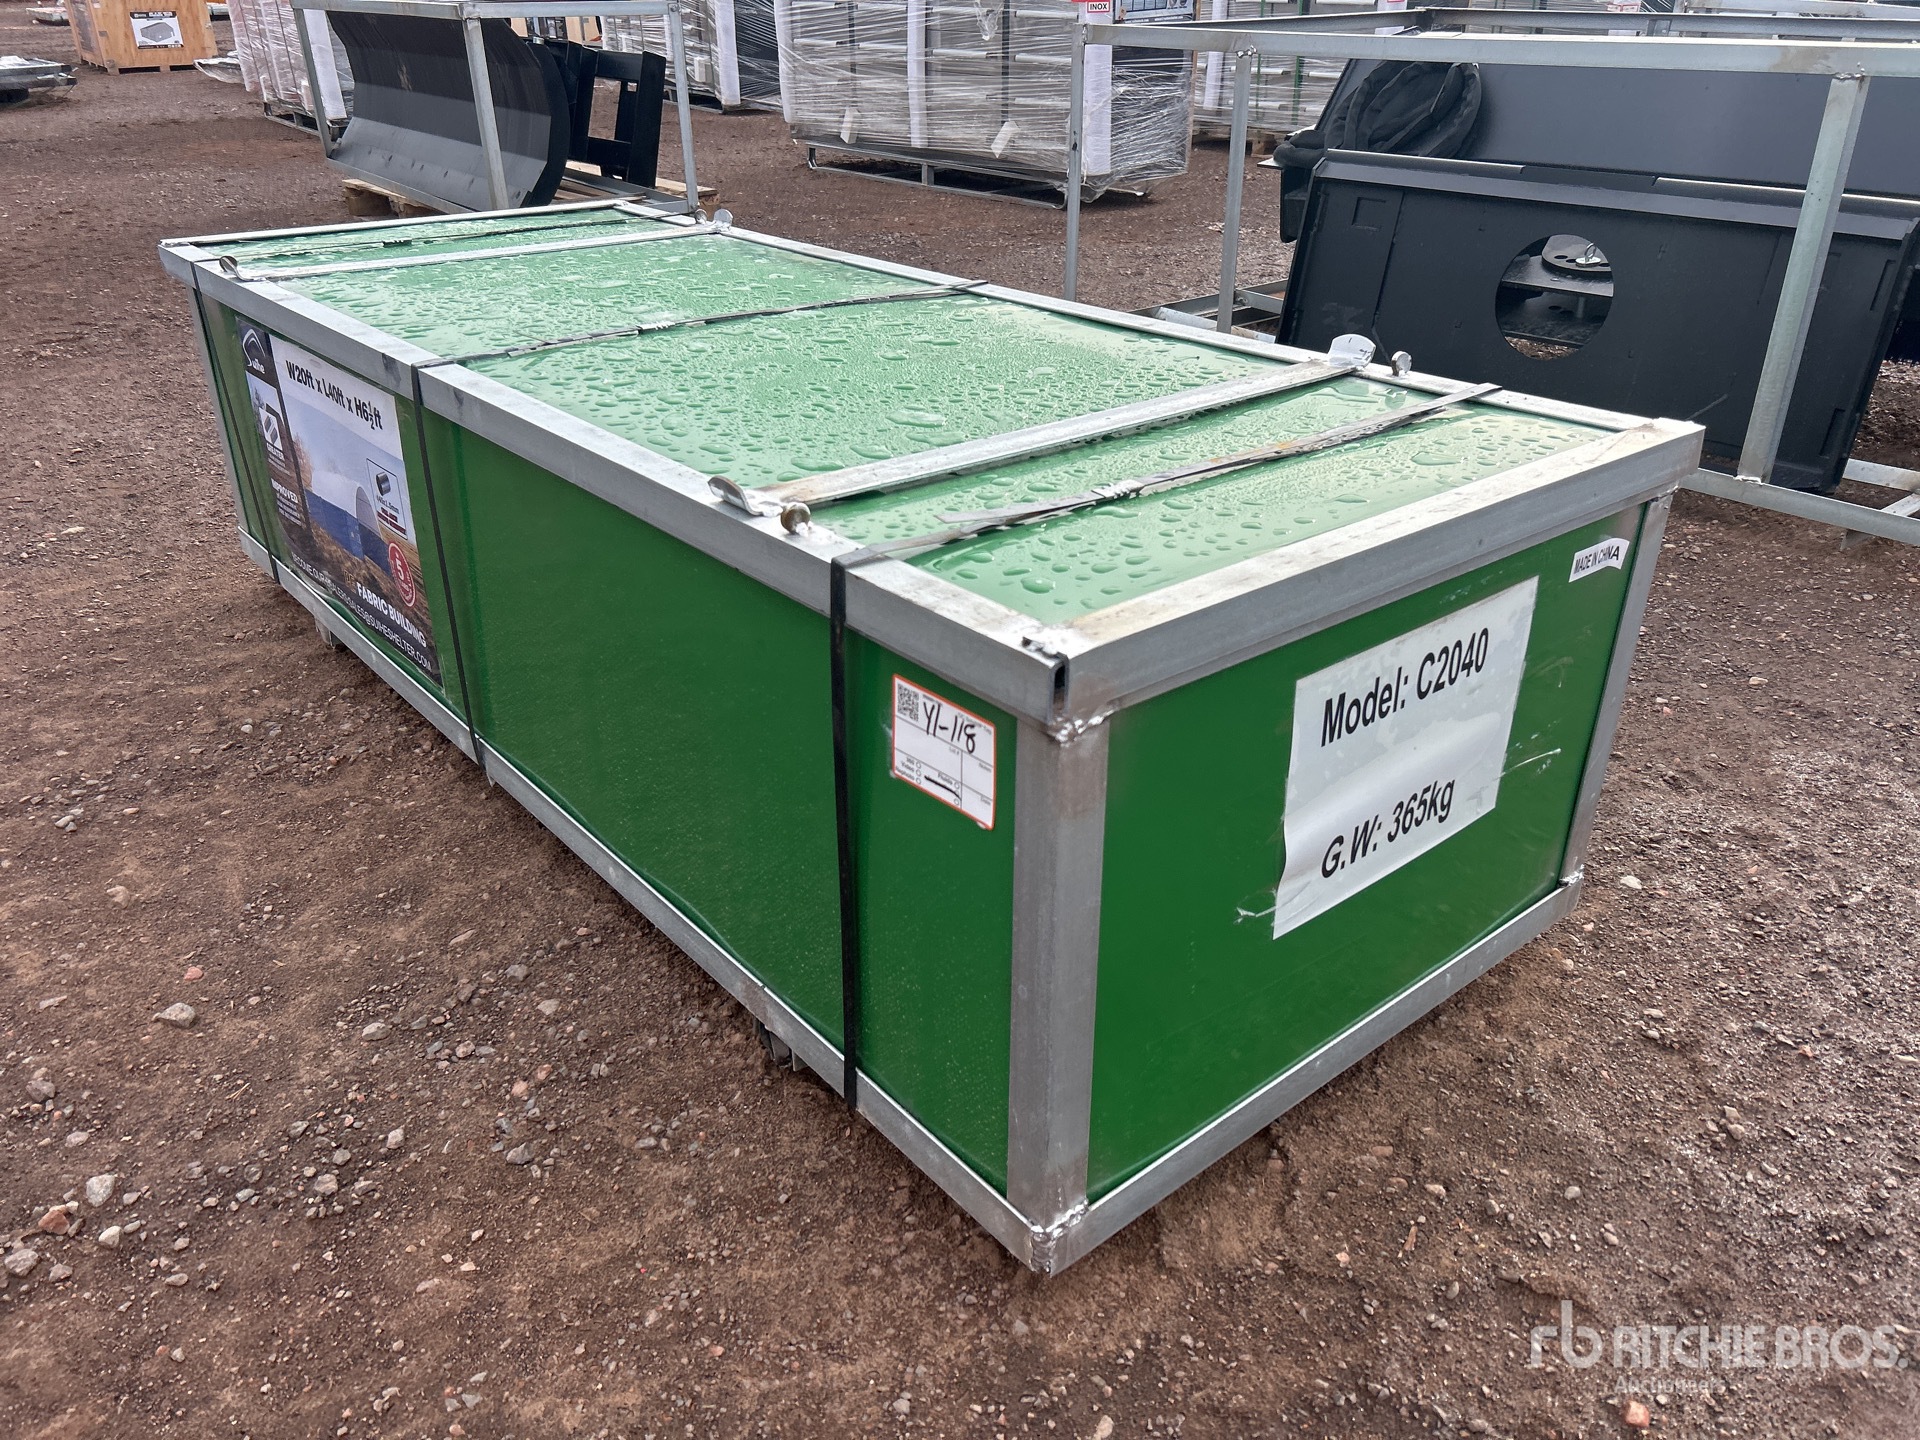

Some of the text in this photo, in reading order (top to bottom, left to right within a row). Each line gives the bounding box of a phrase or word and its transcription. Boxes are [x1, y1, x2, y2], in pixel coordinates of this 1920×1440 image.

[1089, 2, 1108, 10] INOX
[285, 360, 316, 390] W20ft
[315, 378, 323, 394] x
[321, 378, 346, 408] L40ft
[346, 396, 354, 413] x
[1573, 545, 1620, 574] MADE IN CHINA
[356, 581, 389, 616] FABRIC
[388, 604, 428, 648] BUILDING
[1321, 627, 1489, 748] Model: C2040
[1321, 779, 1456, 879] G.W: 365kg
